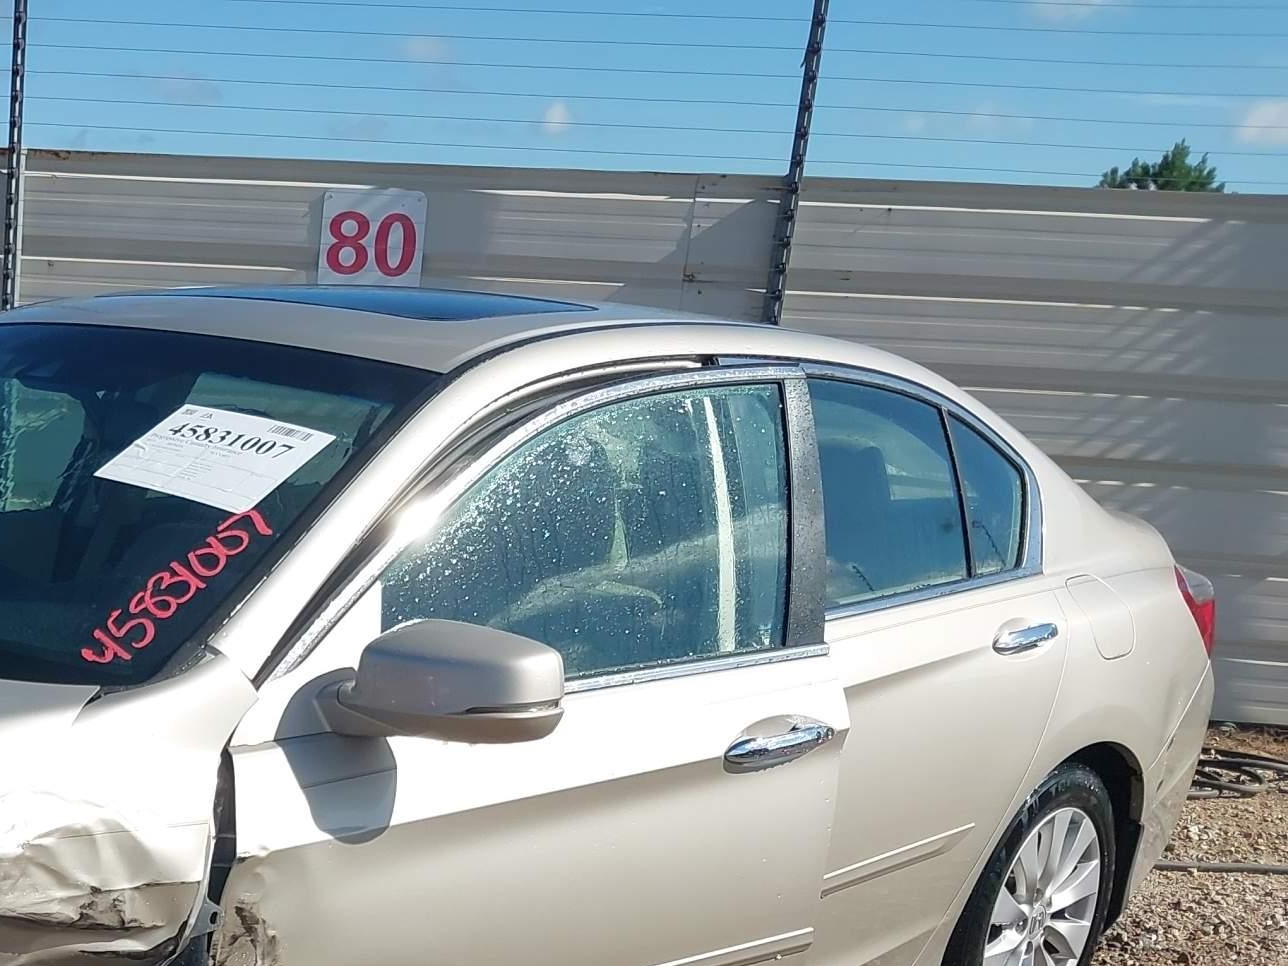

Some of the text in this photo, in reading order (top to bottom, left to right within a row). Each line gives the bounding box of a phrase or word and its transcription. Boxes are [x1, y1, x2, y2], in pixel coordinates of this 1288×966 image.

[325, 210, 418, 277] 80
[168, 422, 296, 459] 45831007
[80, 510, 274, 664] 45831007
